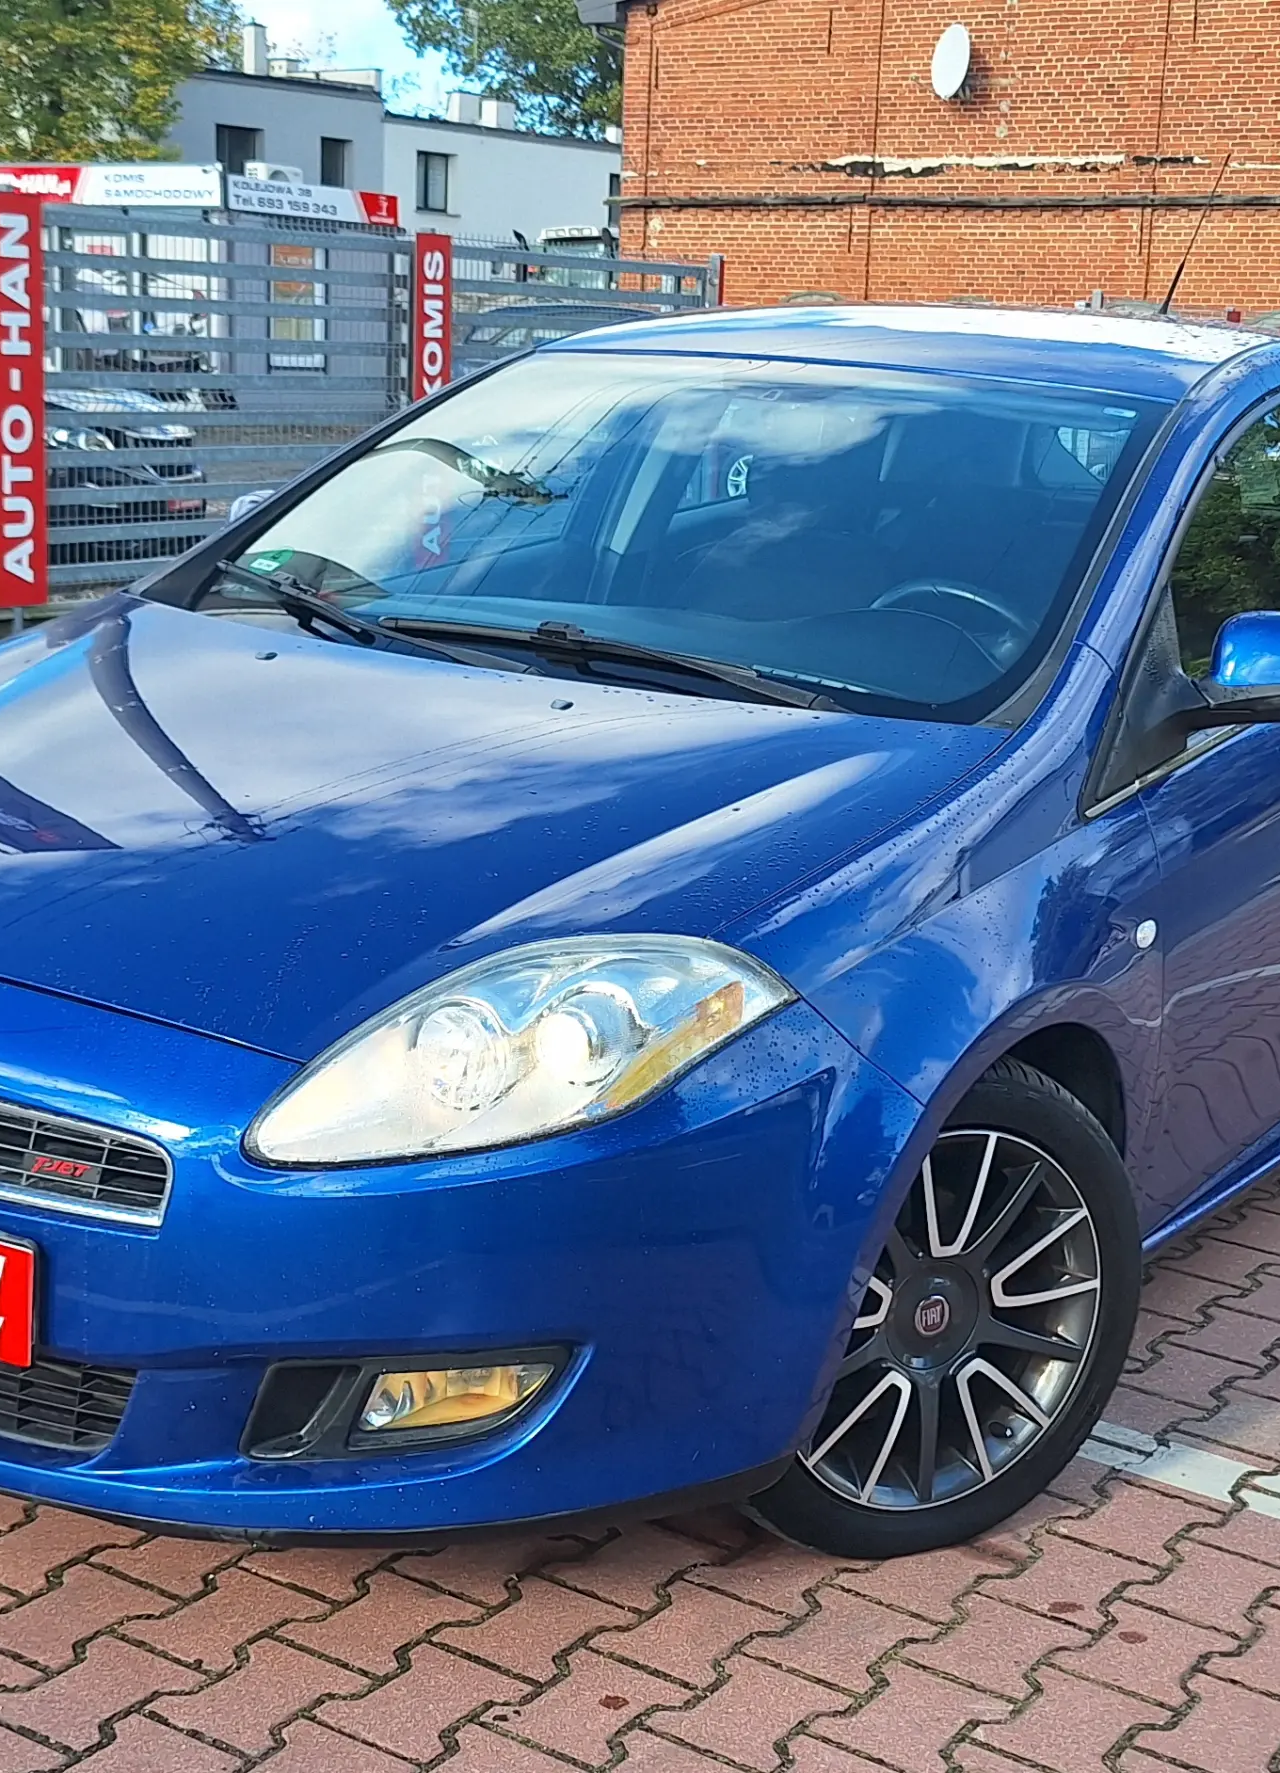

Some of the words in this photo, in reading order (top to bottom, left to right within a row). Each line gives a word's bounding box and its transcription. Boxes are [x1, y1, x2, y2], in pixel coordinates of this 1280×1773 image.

[104, 173, 145, 184] KOMIS
[104, 189, 214, 200] SAMOCHODOWY
[233, 180, 293, 197] KOLEJOWA
[921, 1303, 943, 1327] FIAT
